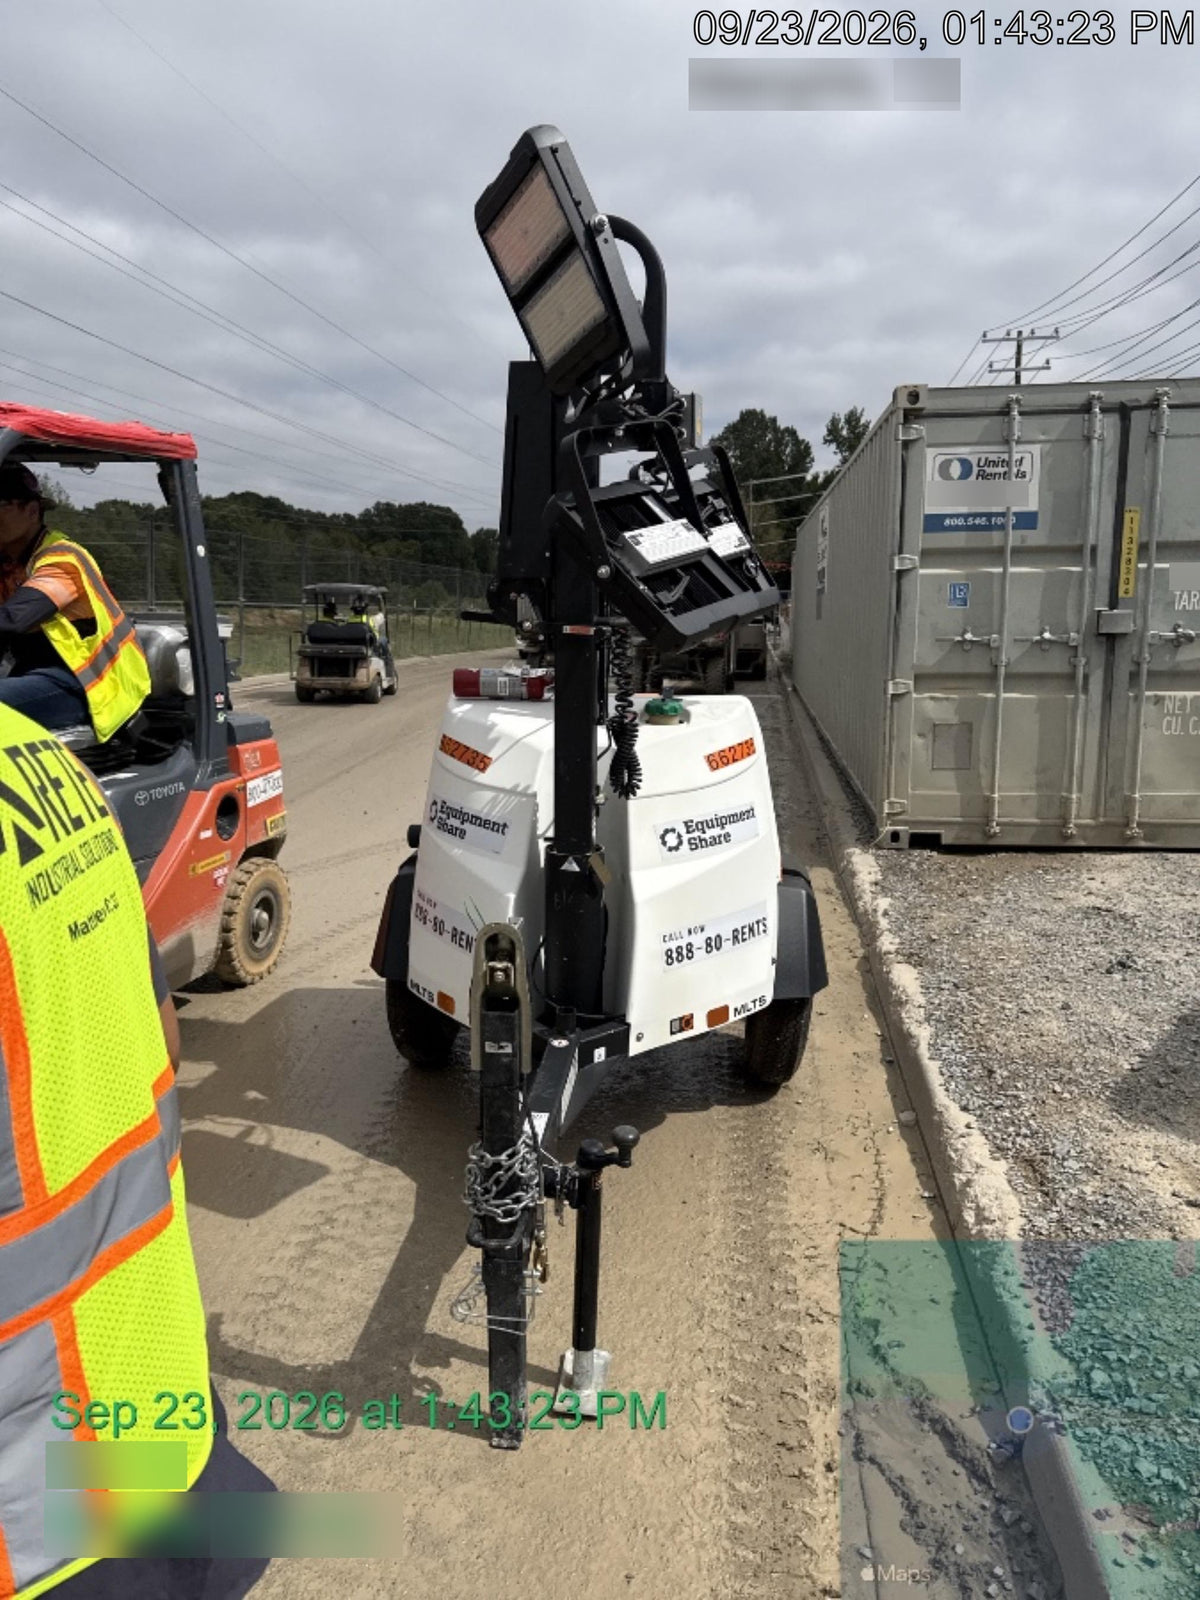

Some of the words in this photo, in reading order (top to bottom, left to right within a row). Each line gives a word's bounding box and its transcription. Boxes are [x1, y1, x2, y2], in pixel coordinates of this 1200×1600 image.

[976, 469, 1027, 481] Rentls
[1173, 591, 1200, 611] TAR
[1189, 716, 1200, 735] C
[149, 782, 185, 800] TOYOTA
[437, 816, 467, 840] Share
[439, 800, 509, 836] Equipment
[688, 831, 732, 851] Share
[662, 931, 684, 943] CALL
[687, 925, 705, 937] NOW
[664, 917, 767, 966] 888-80-RENTS
